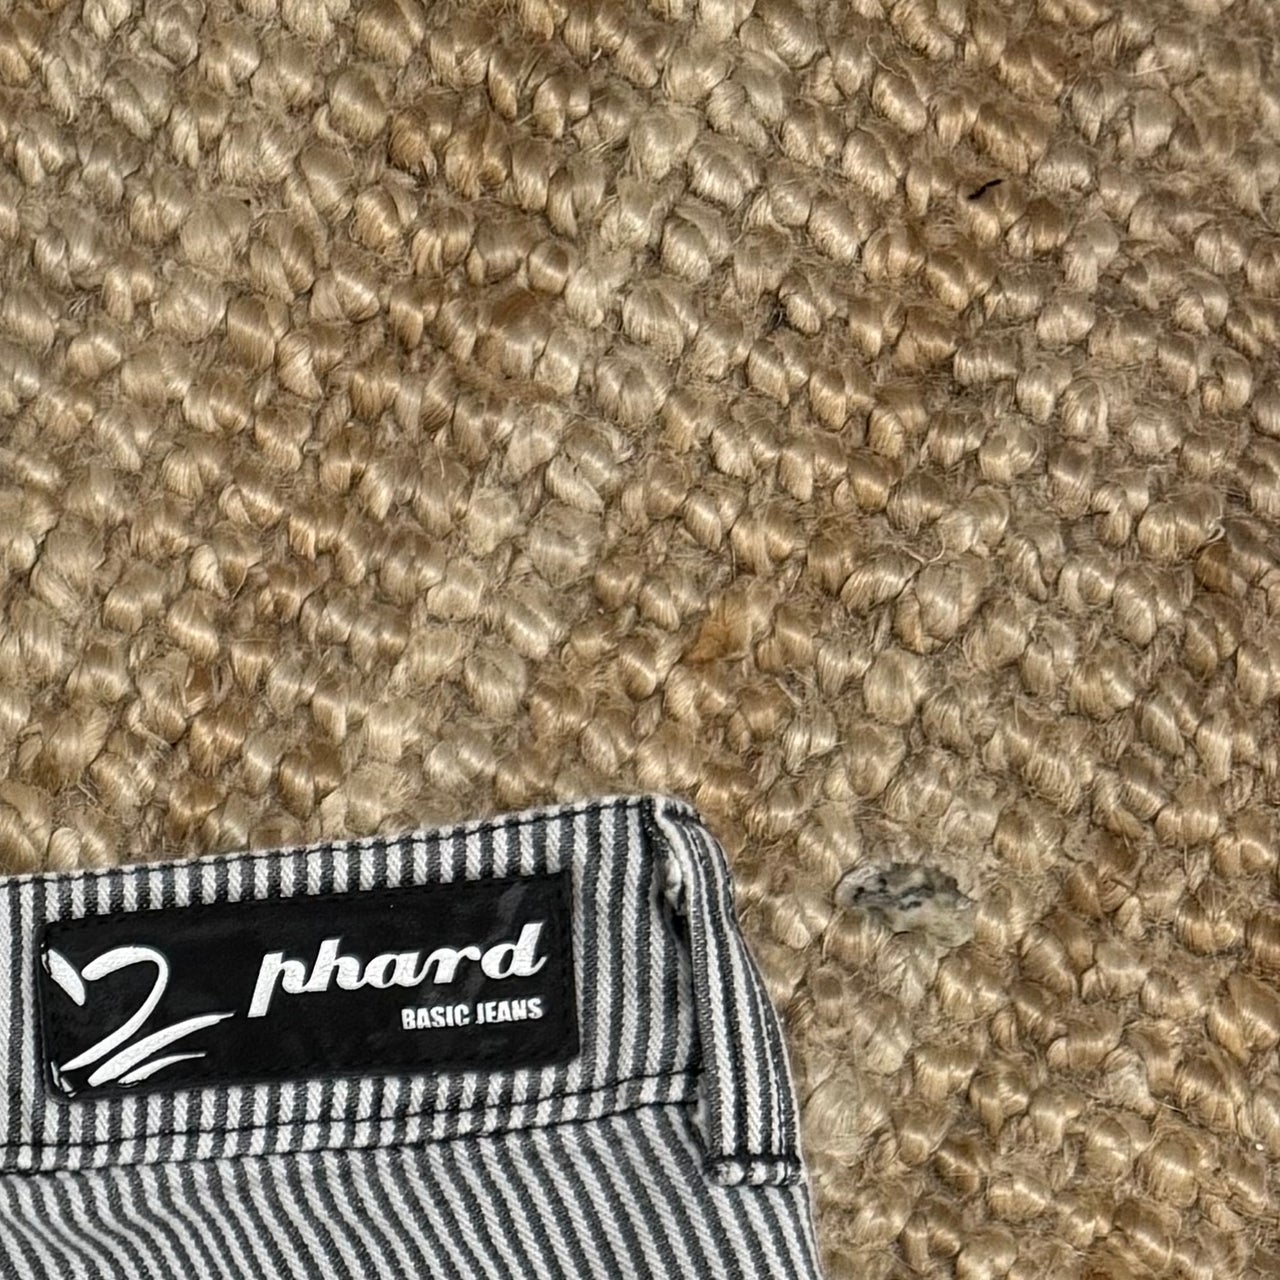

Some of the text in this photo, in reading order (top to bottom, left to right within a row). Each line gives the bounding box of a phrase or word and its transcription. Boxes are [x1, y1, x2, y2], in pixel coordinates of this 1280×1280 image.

[247, 922, 548, 1018] phard
[401, 998, 544, 1030] BASIC JEANS
